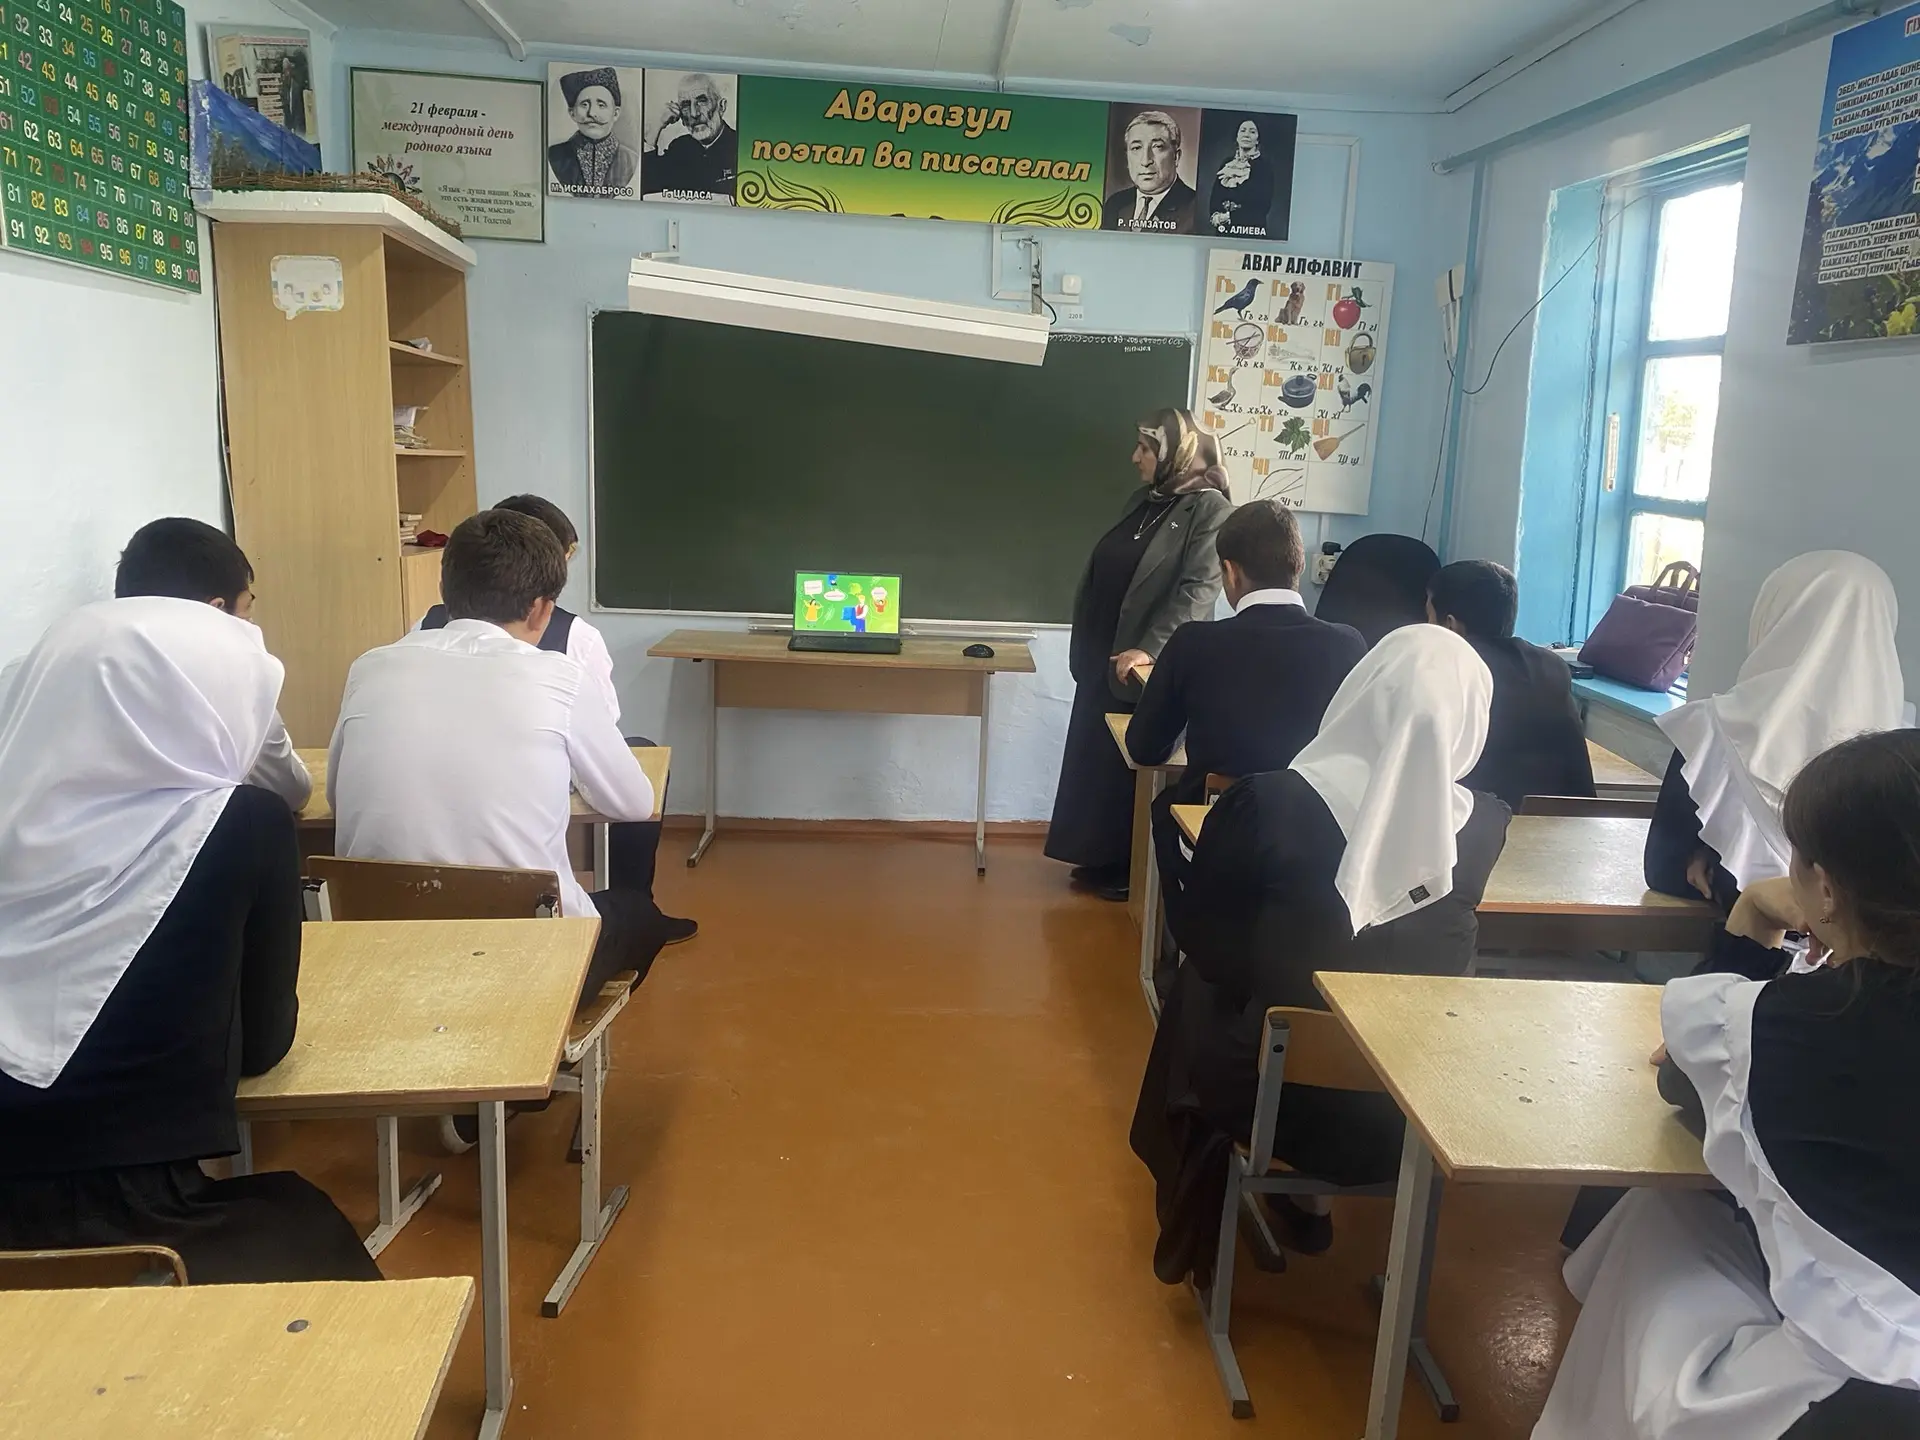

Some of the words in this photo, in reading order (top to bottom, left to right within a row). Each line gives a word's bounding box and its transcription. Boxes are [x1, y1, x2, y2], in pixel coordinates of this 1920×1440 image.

[59, 3, 73, 25] 24
[80, 14, 93, 35] 25
[100, 25, 114, 47] 26
[140, 47, 152, 67] 28
[158, 58, 169, 77] 29
[120, 7, 130, 25] 17
[156, 28, 167, 47] 19
[15, 13, 31, 36] 32
[39, 25, 53, 47] 33
[82, 47, 96, 68] 35
[123, 69, 135, 88] 37
[142, 78, 154, 98] 38
[160, 88, 171, 106] 39
[18, 50, 33, 72] 42
[41, 61, 55, 82] 43
[64, 72, 78, 93] 44
[86, 82, 99, 101] 45
[106, 92, 119, 111] 46
[126, 102, 137, 119] 47
[21, 84, 36, 107] 52
[67, 105, 81, 126] 54
[109, 123, 121, 142] 56
[146, 140, 158, 158] 58
[164, 147, 174, 165] 59
[381, 121, 484, 137] международный
[487, 127, 514, 139] день
[410, 102, 423, 114] 21
[427, 103, 478, 119] февраля
[0, 111, 14, 132] 61
[24, 119, 40, 142] 62
[47, 129, 62, 150] 63
[70, 138, 84, 159] 64
[130, 162, 142, 180] 67
[404, 140, 453, 153] родного
[456, 145, 492, 156] языка
[752, 140, 866, 166] поэтал
[920, 151, 1091, 181] писателал
[3, 146, 17, 168] 71
[27, 154, 43, 176] 72
[73, 171, 87, 191] 74
[93, 178, 107, 198] 75
[113, 185, 126, 204] 76
[150, 199, 162, 217] 78
[167, 206, 178, 223] 79
[183, 211, 194, 228] 80
[673, 190, 712, 200] ЦАДАСА
[7, 183, 21, 204] 81
[31, 190, 46, 211] 82
[54, 197, 69, 217] 83
[97, 210, 109, 229] 85
[116, 217, 129, 235] 86
[135, 223, 146, 240] 87
[153, 229, 164, 246] 88
[185, 240, 196, 256] 90
[483, 216, 511, 225] Толстой
[1118, 218, 1126, 227] Р.
[1129, 219, 1177, 229] ГАМЗАТОВ
[1218, 225, 1228, 233] Ф.
[1230, 226, 1266, 235] АЛИЕВА
[11, 219, 25, 239] 91
[34, 225, 51, 245] 92
[58, 231, 72, 251] 93
[100, 243, 113, 261] 95
[119, 248, 131, 266] 96
[138, 254, 148, 271] 97
[155, 259, 166, 276] 98
[171, 263, 182, 280] 99
[186, 268, 199, 284] 100
[1242, 254, 1282, 272] АВАР
[1286, 257, 1362, 278] АЛФАВИТ
